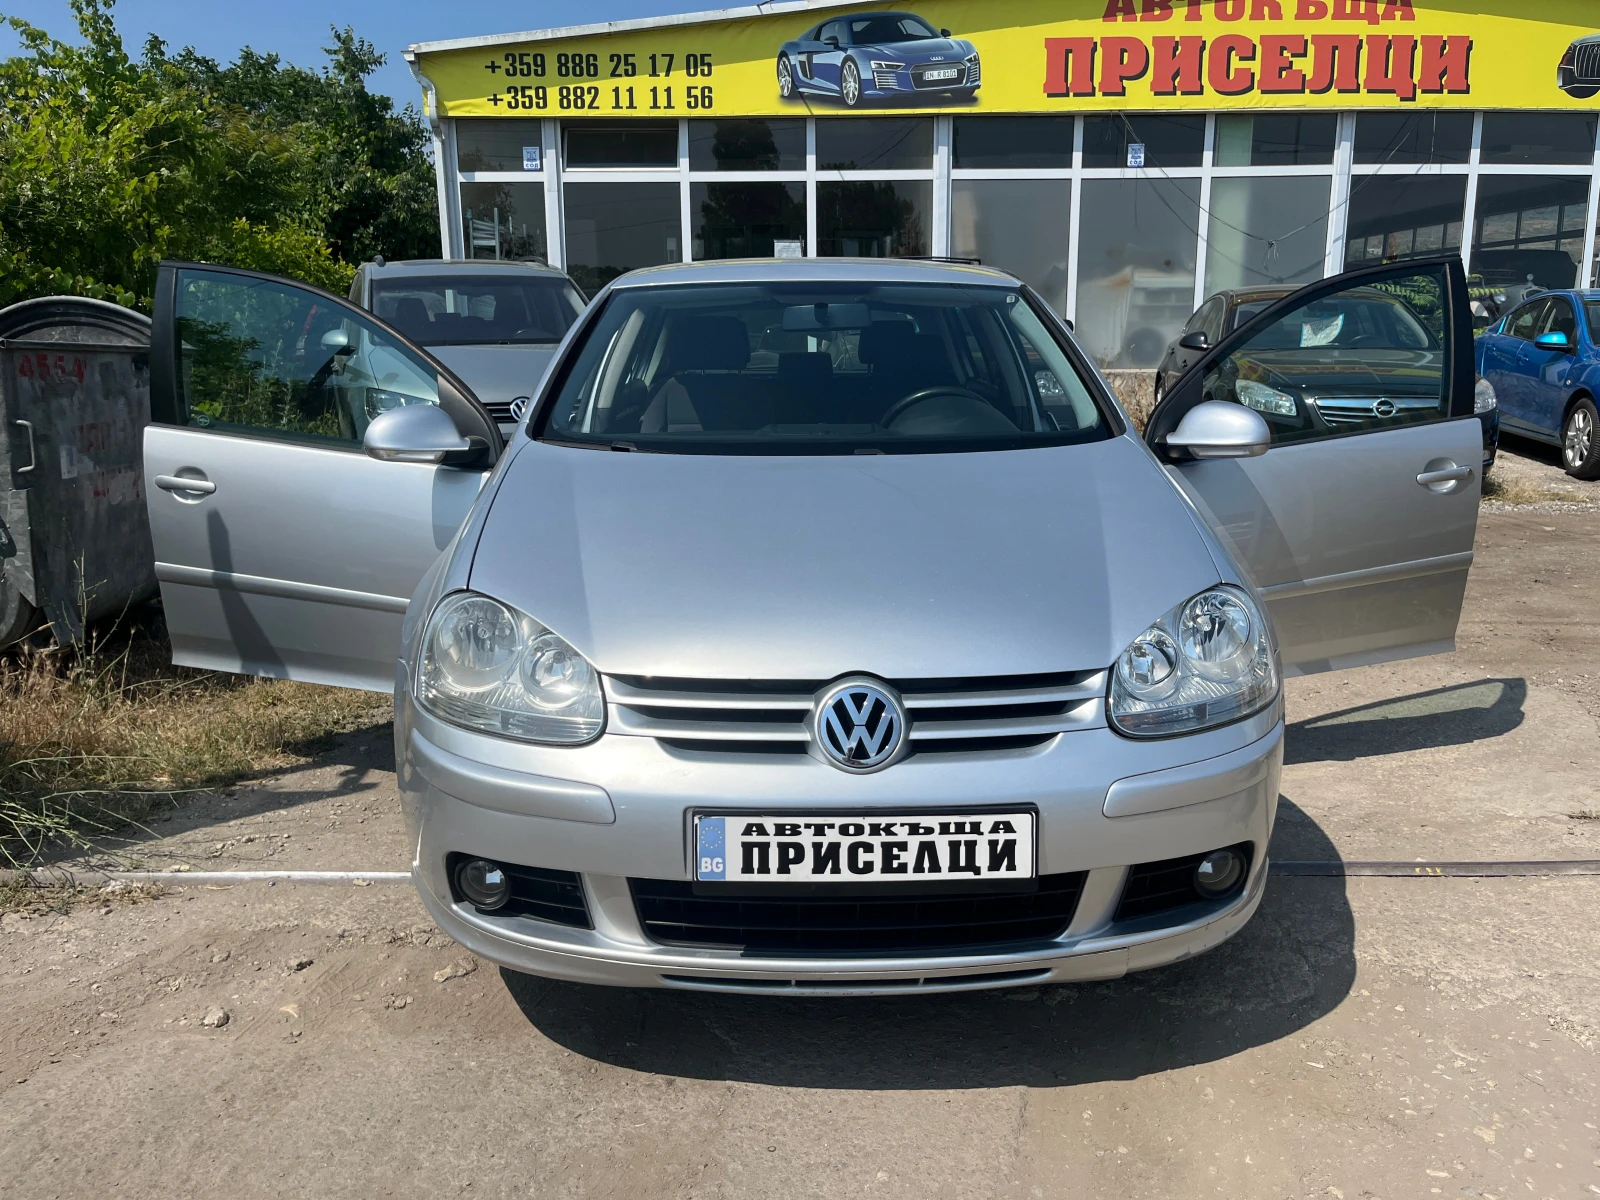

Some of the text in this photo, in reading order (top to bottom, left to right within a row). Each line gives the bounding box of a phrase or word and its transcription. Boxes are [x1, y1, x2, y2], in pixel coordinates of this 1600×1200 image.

[485, 53, 713, 77] +359 886 25 17 05
[1043, 34, 1473, 101] ПРИСЕЛЦИ
[487, 86, 713, 110] +359 882 11 11 56
[740, 820, 1017, 837] АВТОКЪЩА
[701, 857, 724, 873] BG
[740, 839, 1017, 875] ПРИСЕЛЦИ
